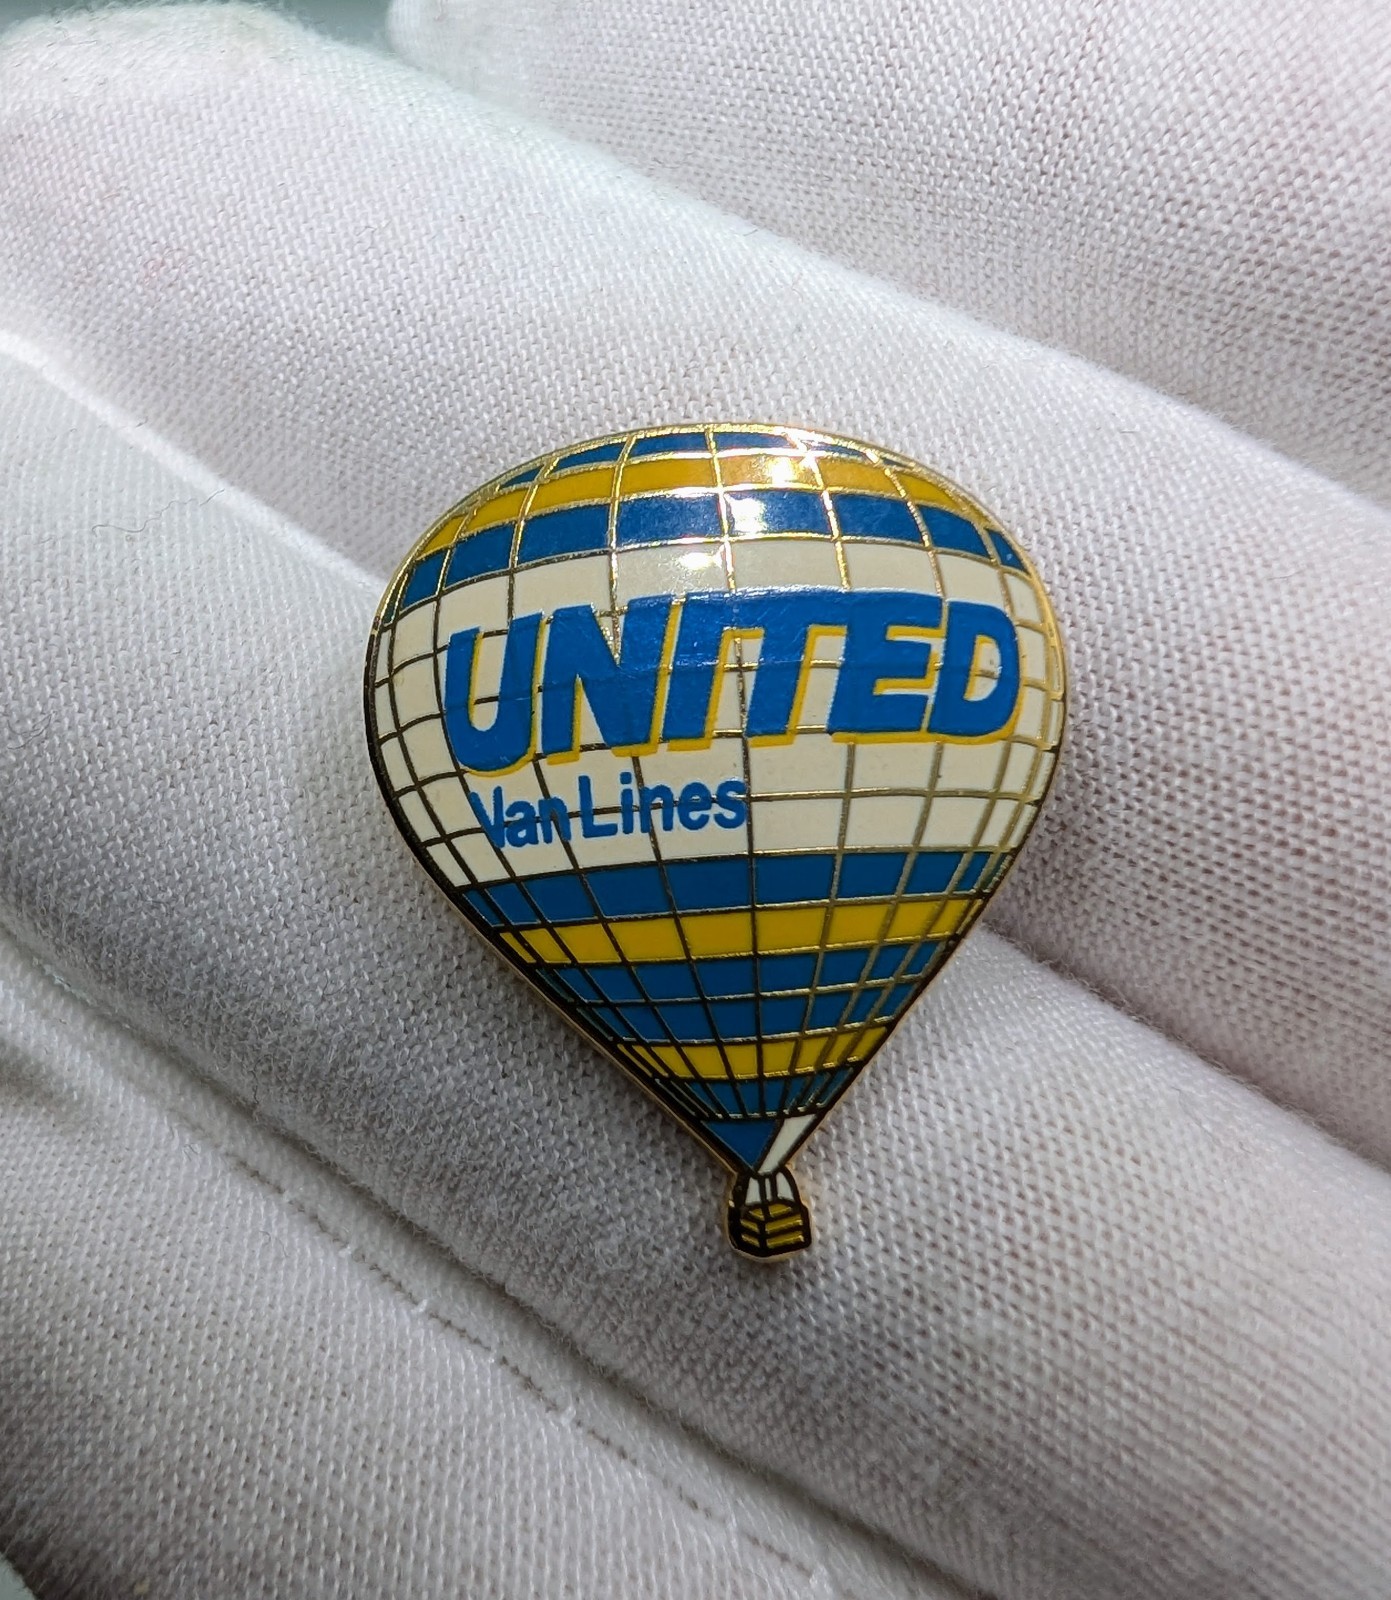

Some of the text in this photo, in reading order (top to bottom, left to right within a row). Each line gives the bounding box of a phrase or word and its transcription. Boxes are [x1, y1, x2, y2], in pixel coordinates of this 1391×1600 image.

[444, 588, 1021, 775] UNITED
[469, 771, 748, 848] Van Lines
